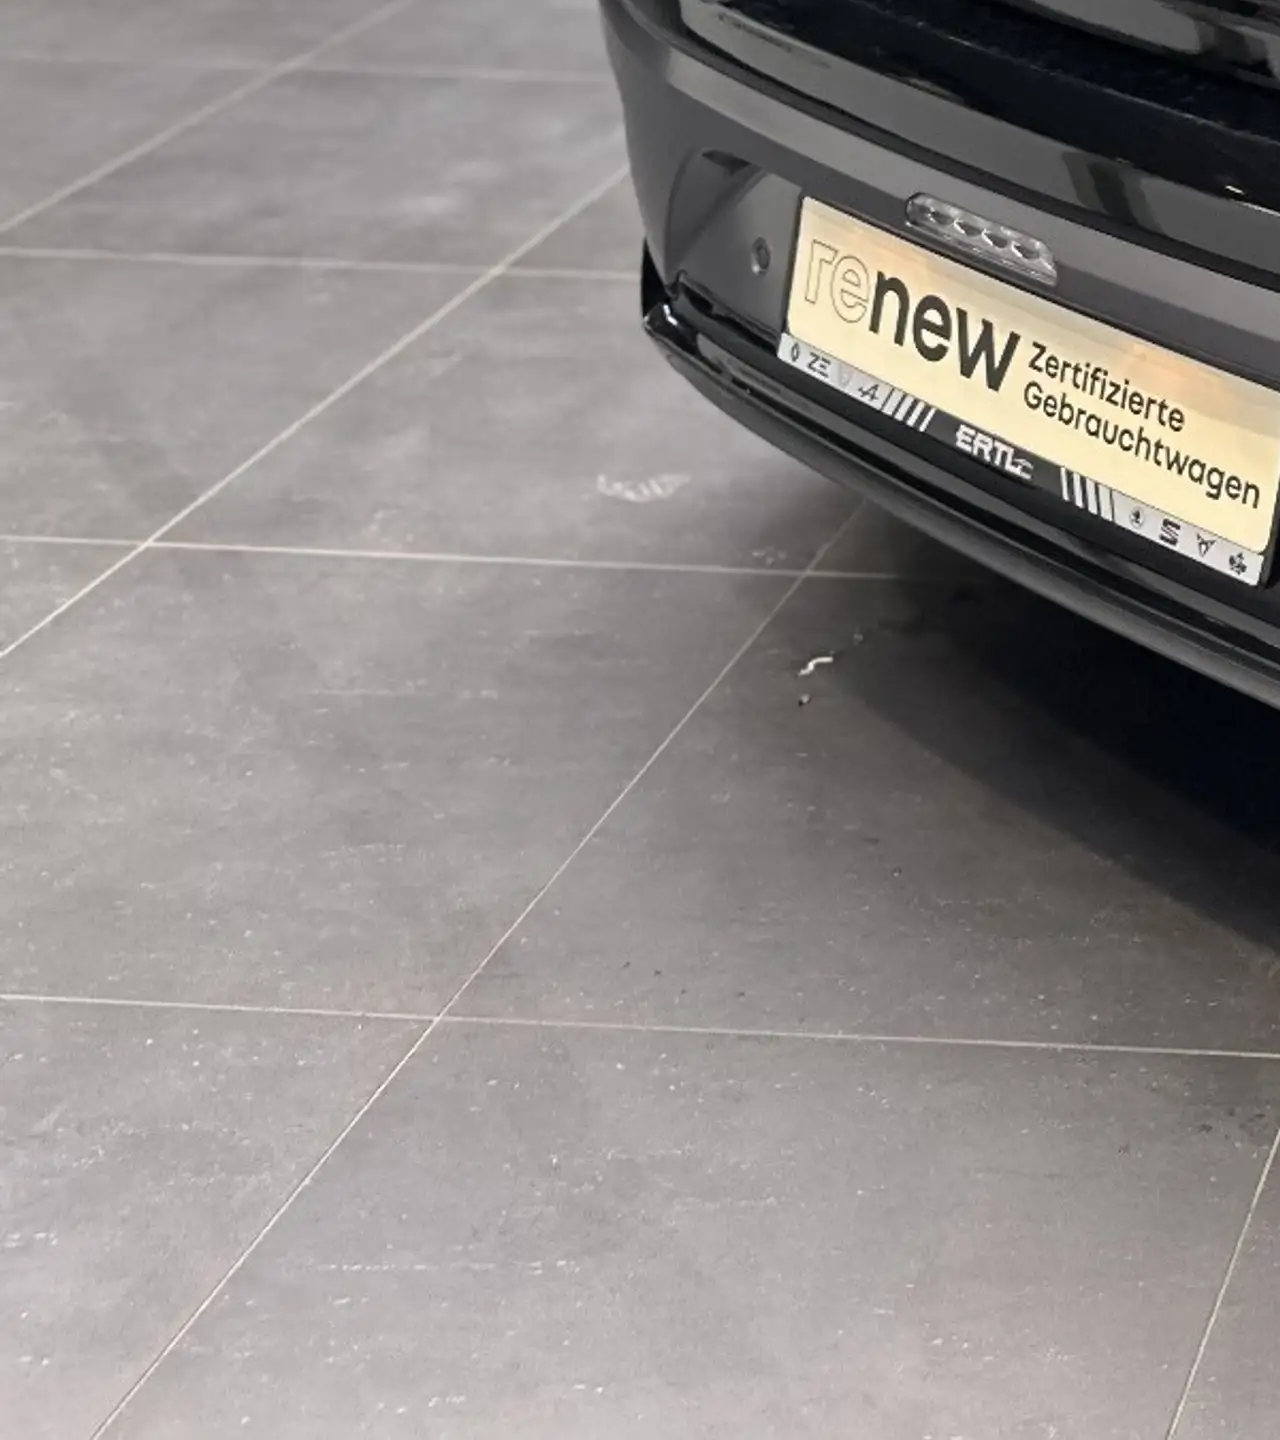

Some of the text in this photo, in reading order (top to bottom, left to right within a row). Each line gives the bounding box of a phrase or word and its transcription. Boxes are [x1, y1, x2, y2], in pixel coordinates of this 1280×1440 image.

[804, 238, 1021, 393] renew
[1023, 380, 1261, 509] Gebrauchtwagen
[1028, 340, 1186, 432] Zertifizierte
